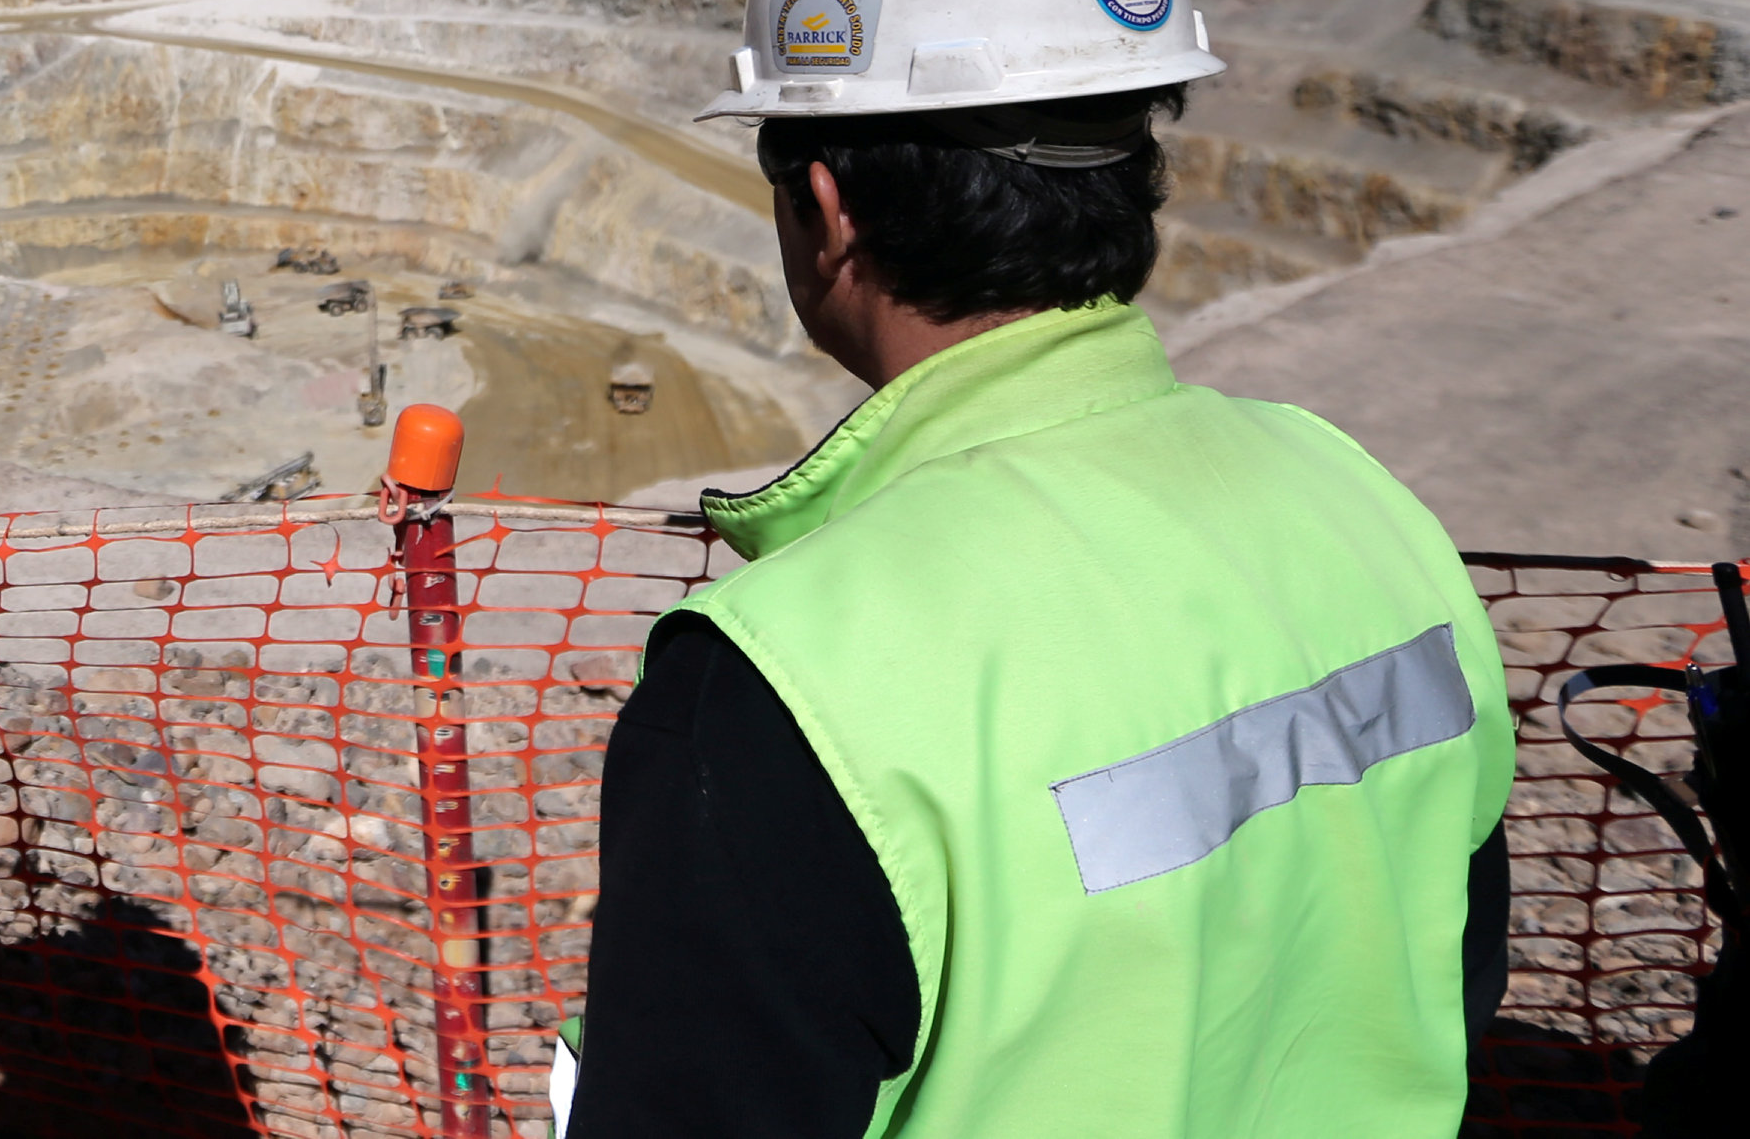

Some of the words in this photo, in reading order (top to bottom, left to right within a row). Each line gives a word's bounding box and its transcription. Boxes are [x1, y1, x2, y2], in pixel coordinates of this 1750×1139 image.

[1107, 1, 1123, 16] CON
[1123, 13, 1152, 24] TIEMPO
[787, 30, 846, 44] BARRICK
[849, 14, 863, 56] SOLIDO
[810, 56, 851, 66] SEGURIDAD
